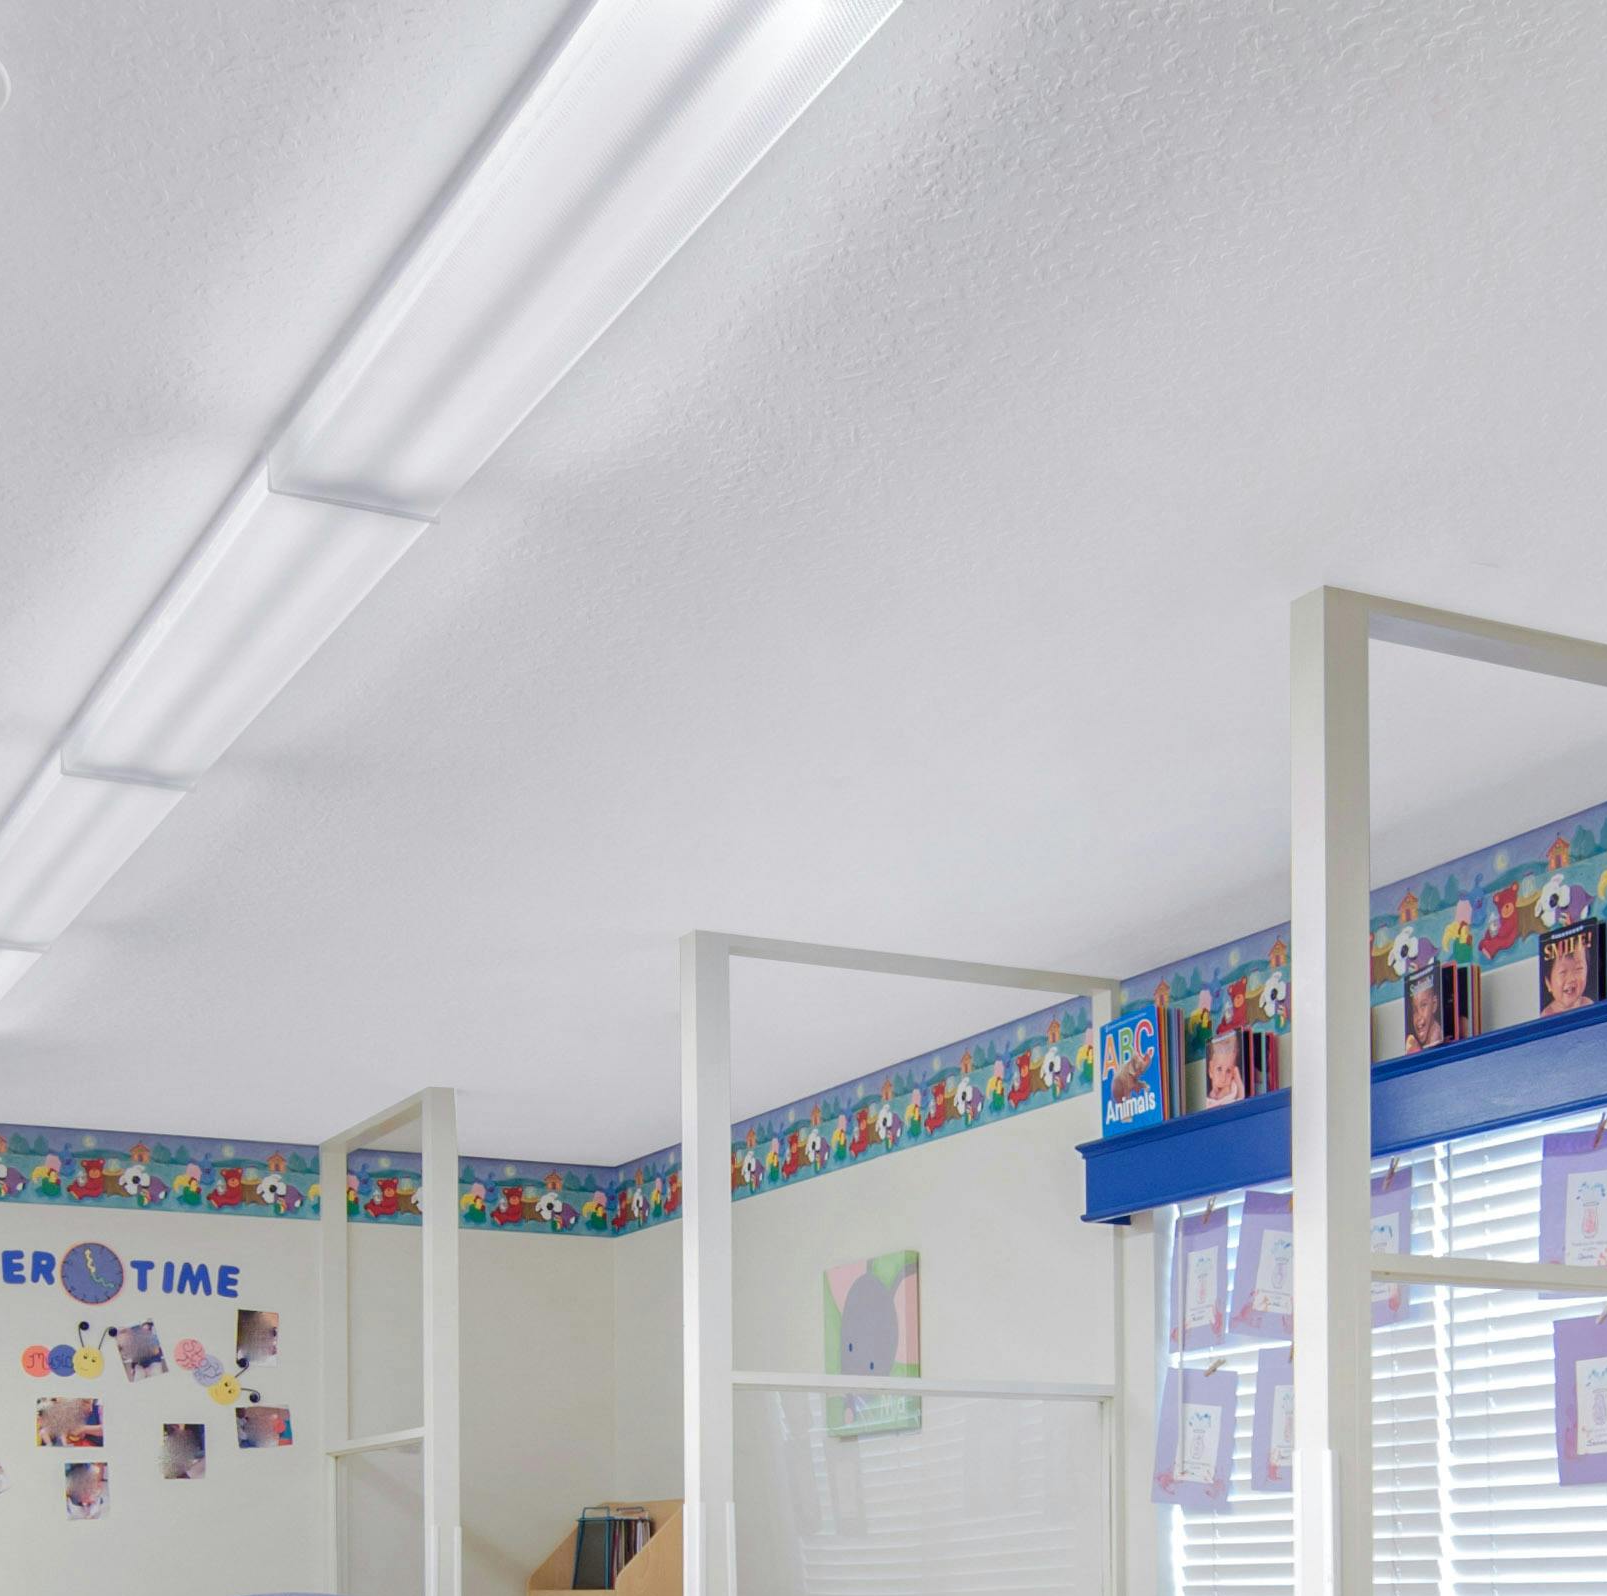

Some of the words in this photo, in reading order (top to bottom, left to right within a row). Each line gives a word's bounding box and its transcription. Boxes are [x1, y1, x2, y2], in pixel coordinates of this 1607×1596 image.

[1102, 1018, 1154, 1081] ABC
[1105, 1091, 1156, 1125] Animals
[130, 1260, 240, 1299] TIME
